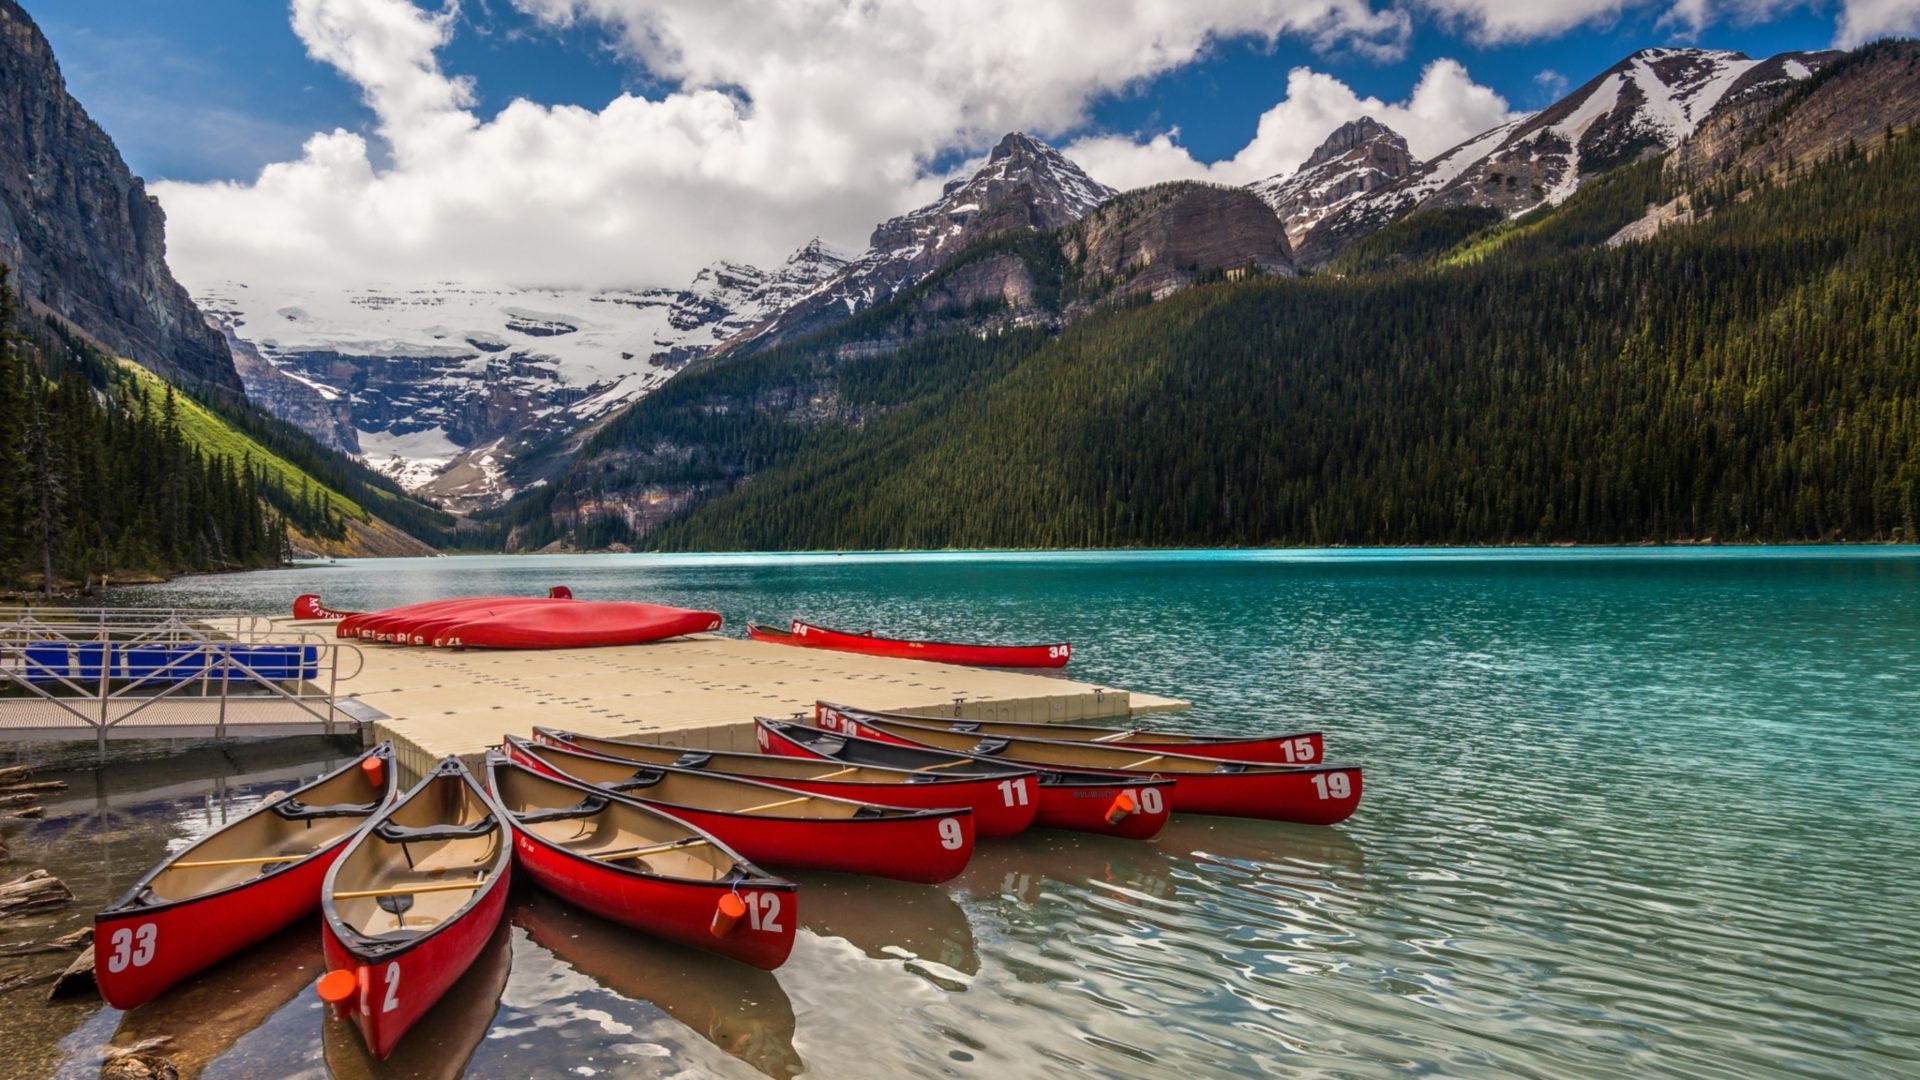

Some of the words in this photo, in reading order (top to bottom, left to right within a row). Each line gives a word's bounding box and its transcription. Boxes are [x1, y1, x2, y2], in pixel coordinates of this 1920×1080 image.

[446, 637, 463, 646] 17
[793, 622, 807, 636] 34
[1049, 645, 1068, 658] 34
[819, 707, 837, 729] 15
[840, 718, 857, 736] 19
[758, 725, 769, 749] 40
[1280, 737, 1315, 763] 15
[998, 778, 1029, 807] 11
[1311, 772, 1351, 800] 19
[938, 818, 963, 850] 9
[744, 891, 783, 933] 12
[108, 922, 158, 973] 33
[382, 961, 400, 1013] 2
